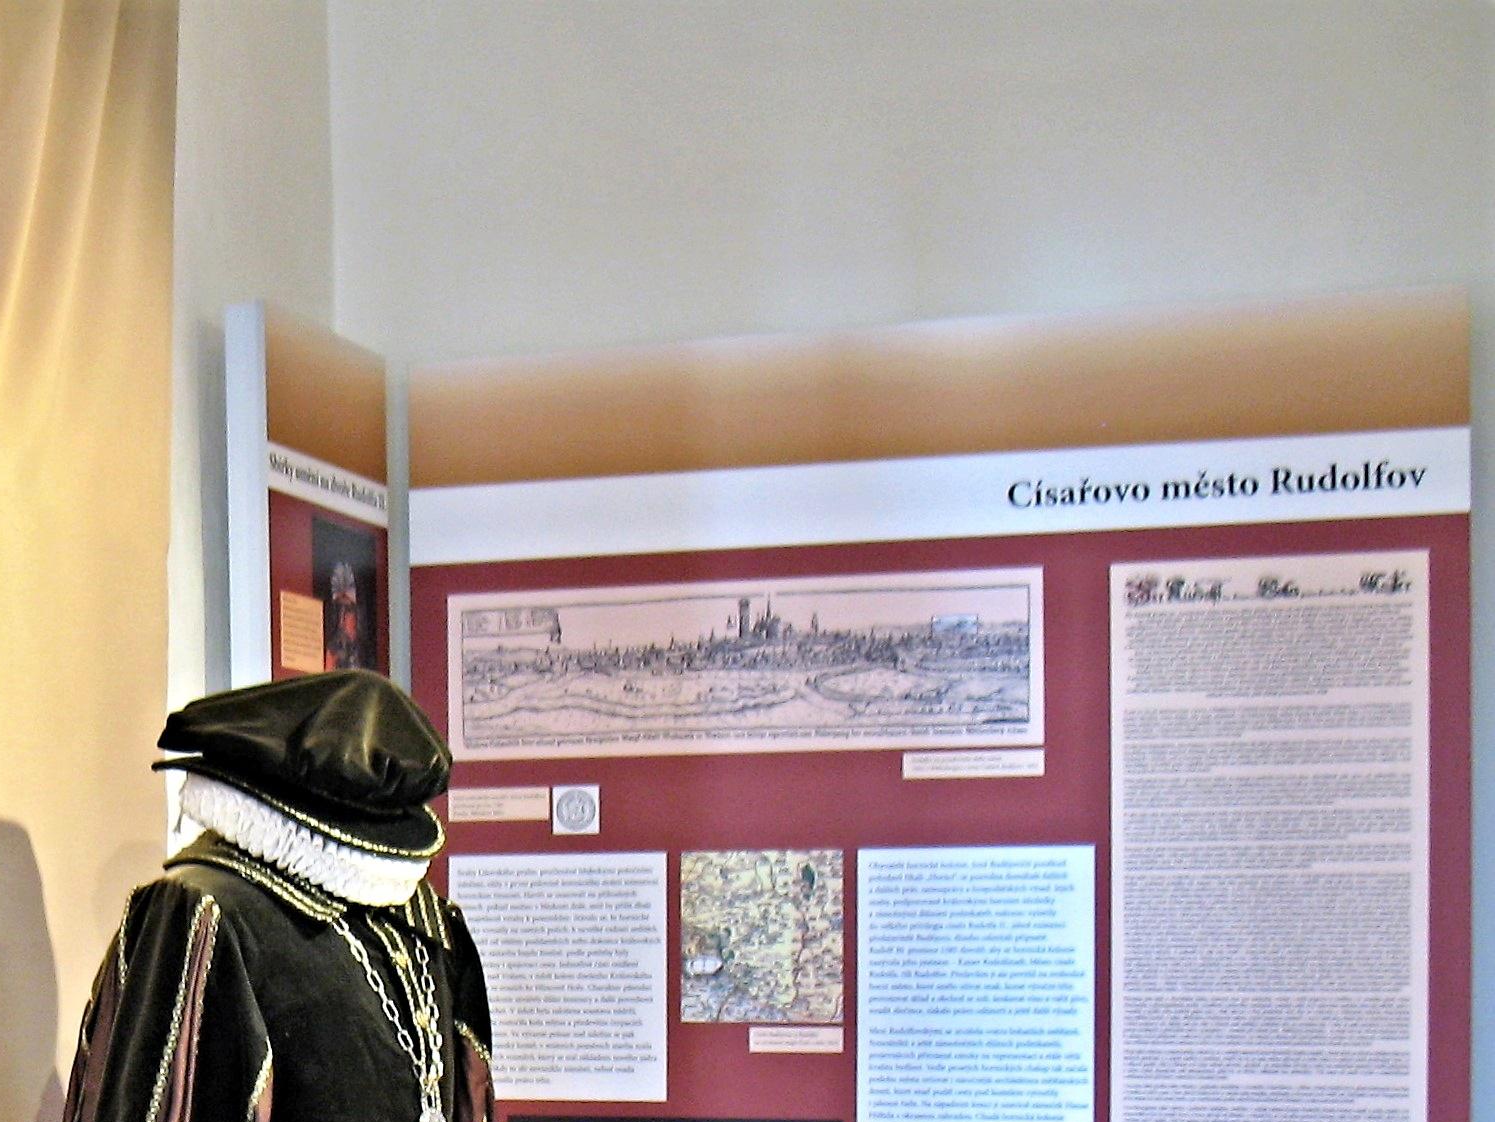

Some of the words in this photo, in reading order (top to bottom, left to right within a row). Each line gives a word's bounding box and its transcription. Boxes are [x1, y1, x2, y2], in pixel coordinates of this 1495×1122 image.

[1007, 477, 1151, 508] Císařovo
[1161, 469, 1259, 501] město
[1271, 459, 1427, 495] Rudolfov
